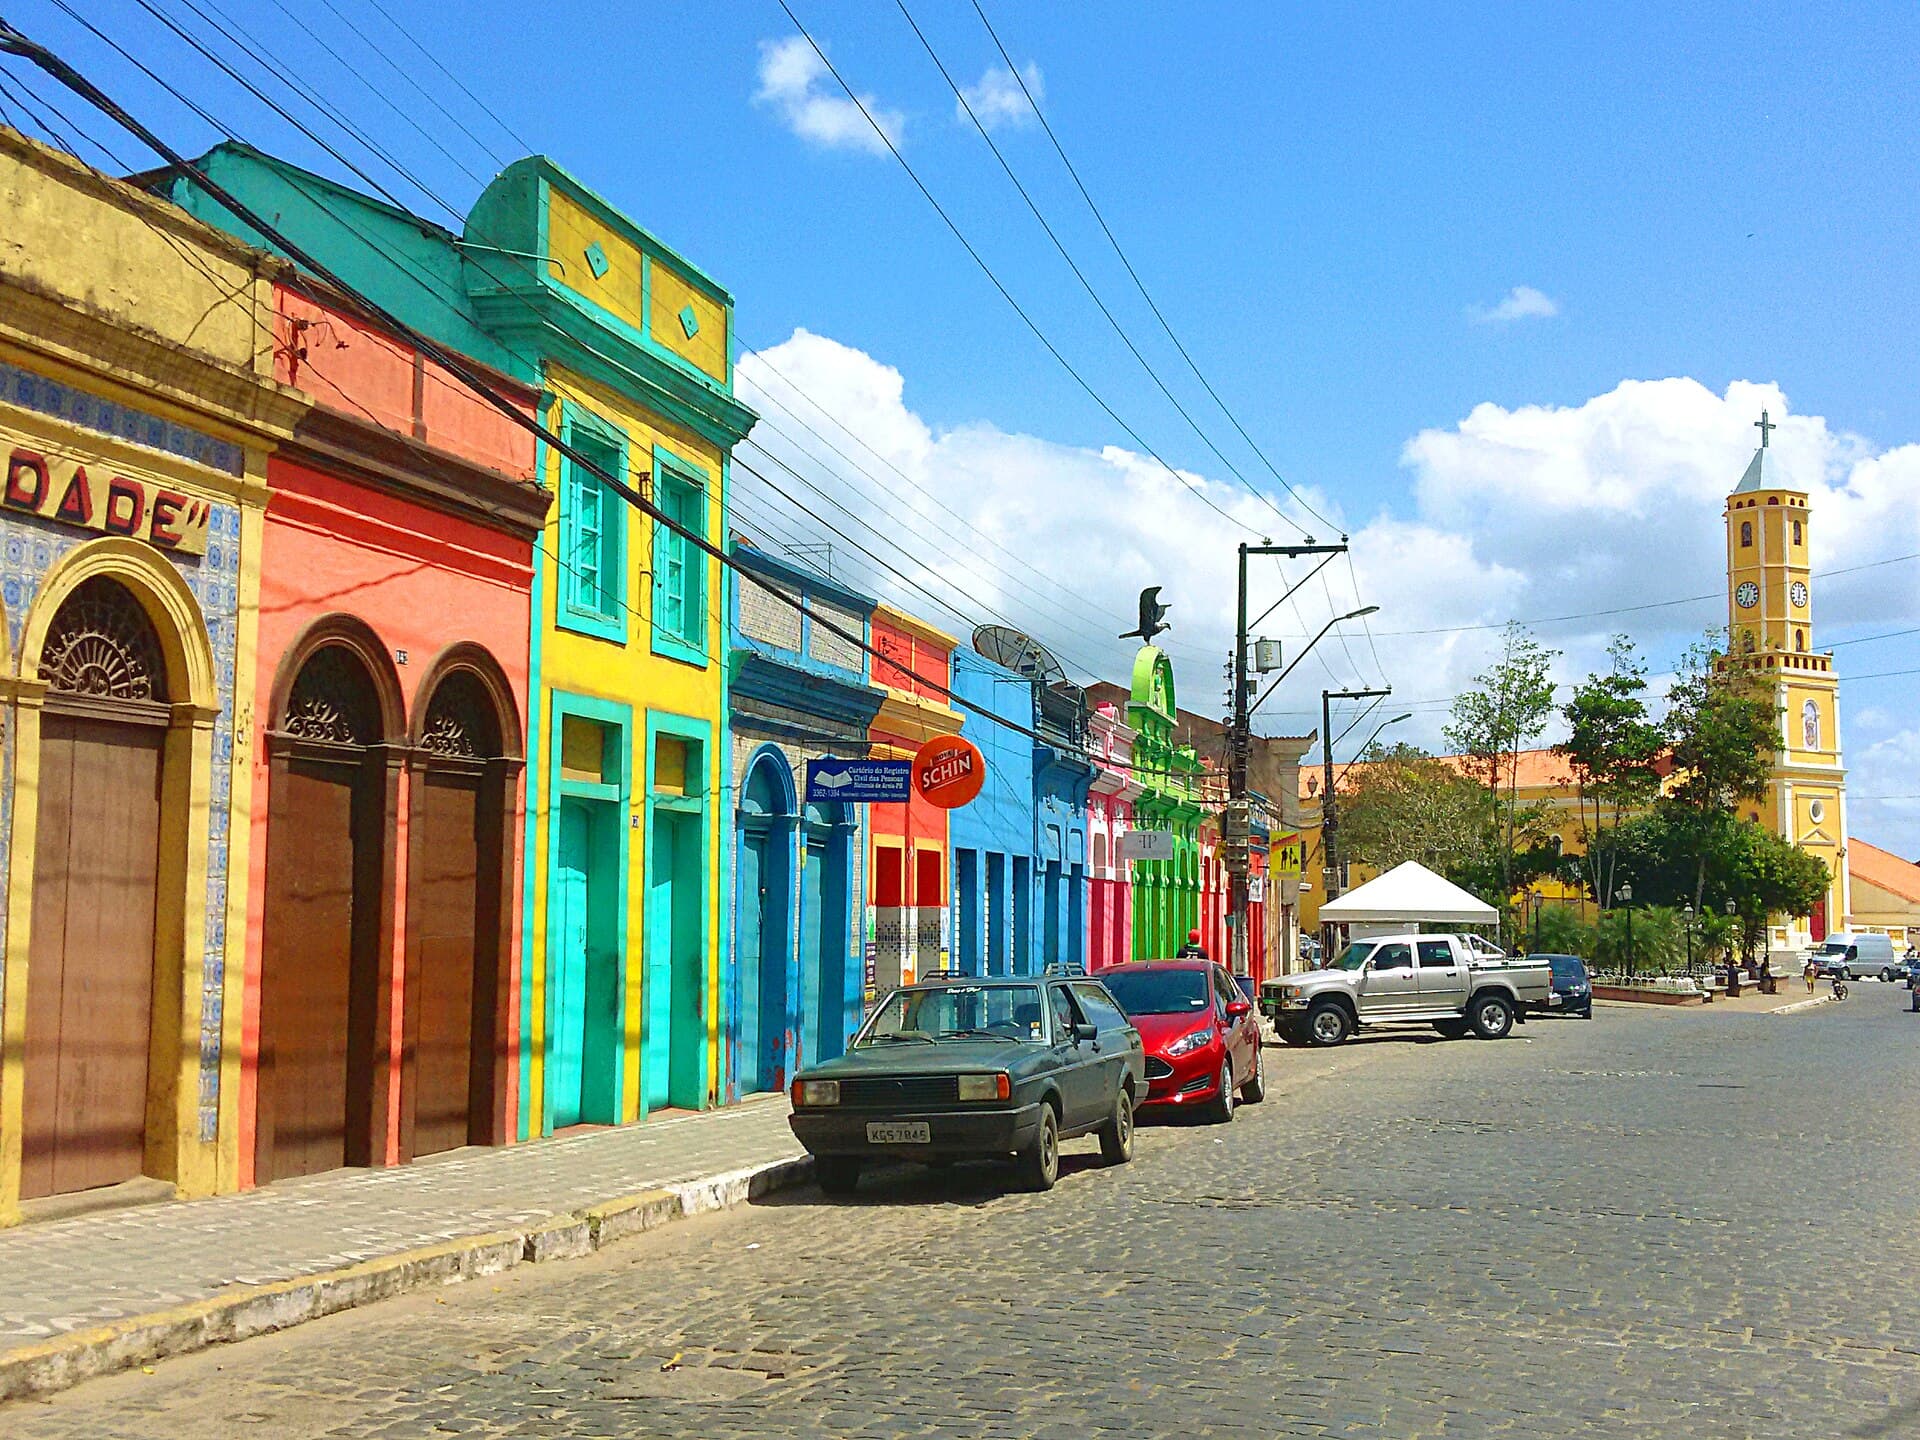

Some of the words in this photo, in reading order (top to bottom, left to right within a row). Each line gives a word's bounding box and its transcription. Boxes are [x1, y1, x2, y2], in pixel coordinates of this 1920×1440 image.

[874, 766, 883, 774] do
[883, 767, 910, 776] Registro
[922, 755, 971, 788] SCHIN
[853, 774, 868, 782] Civil
